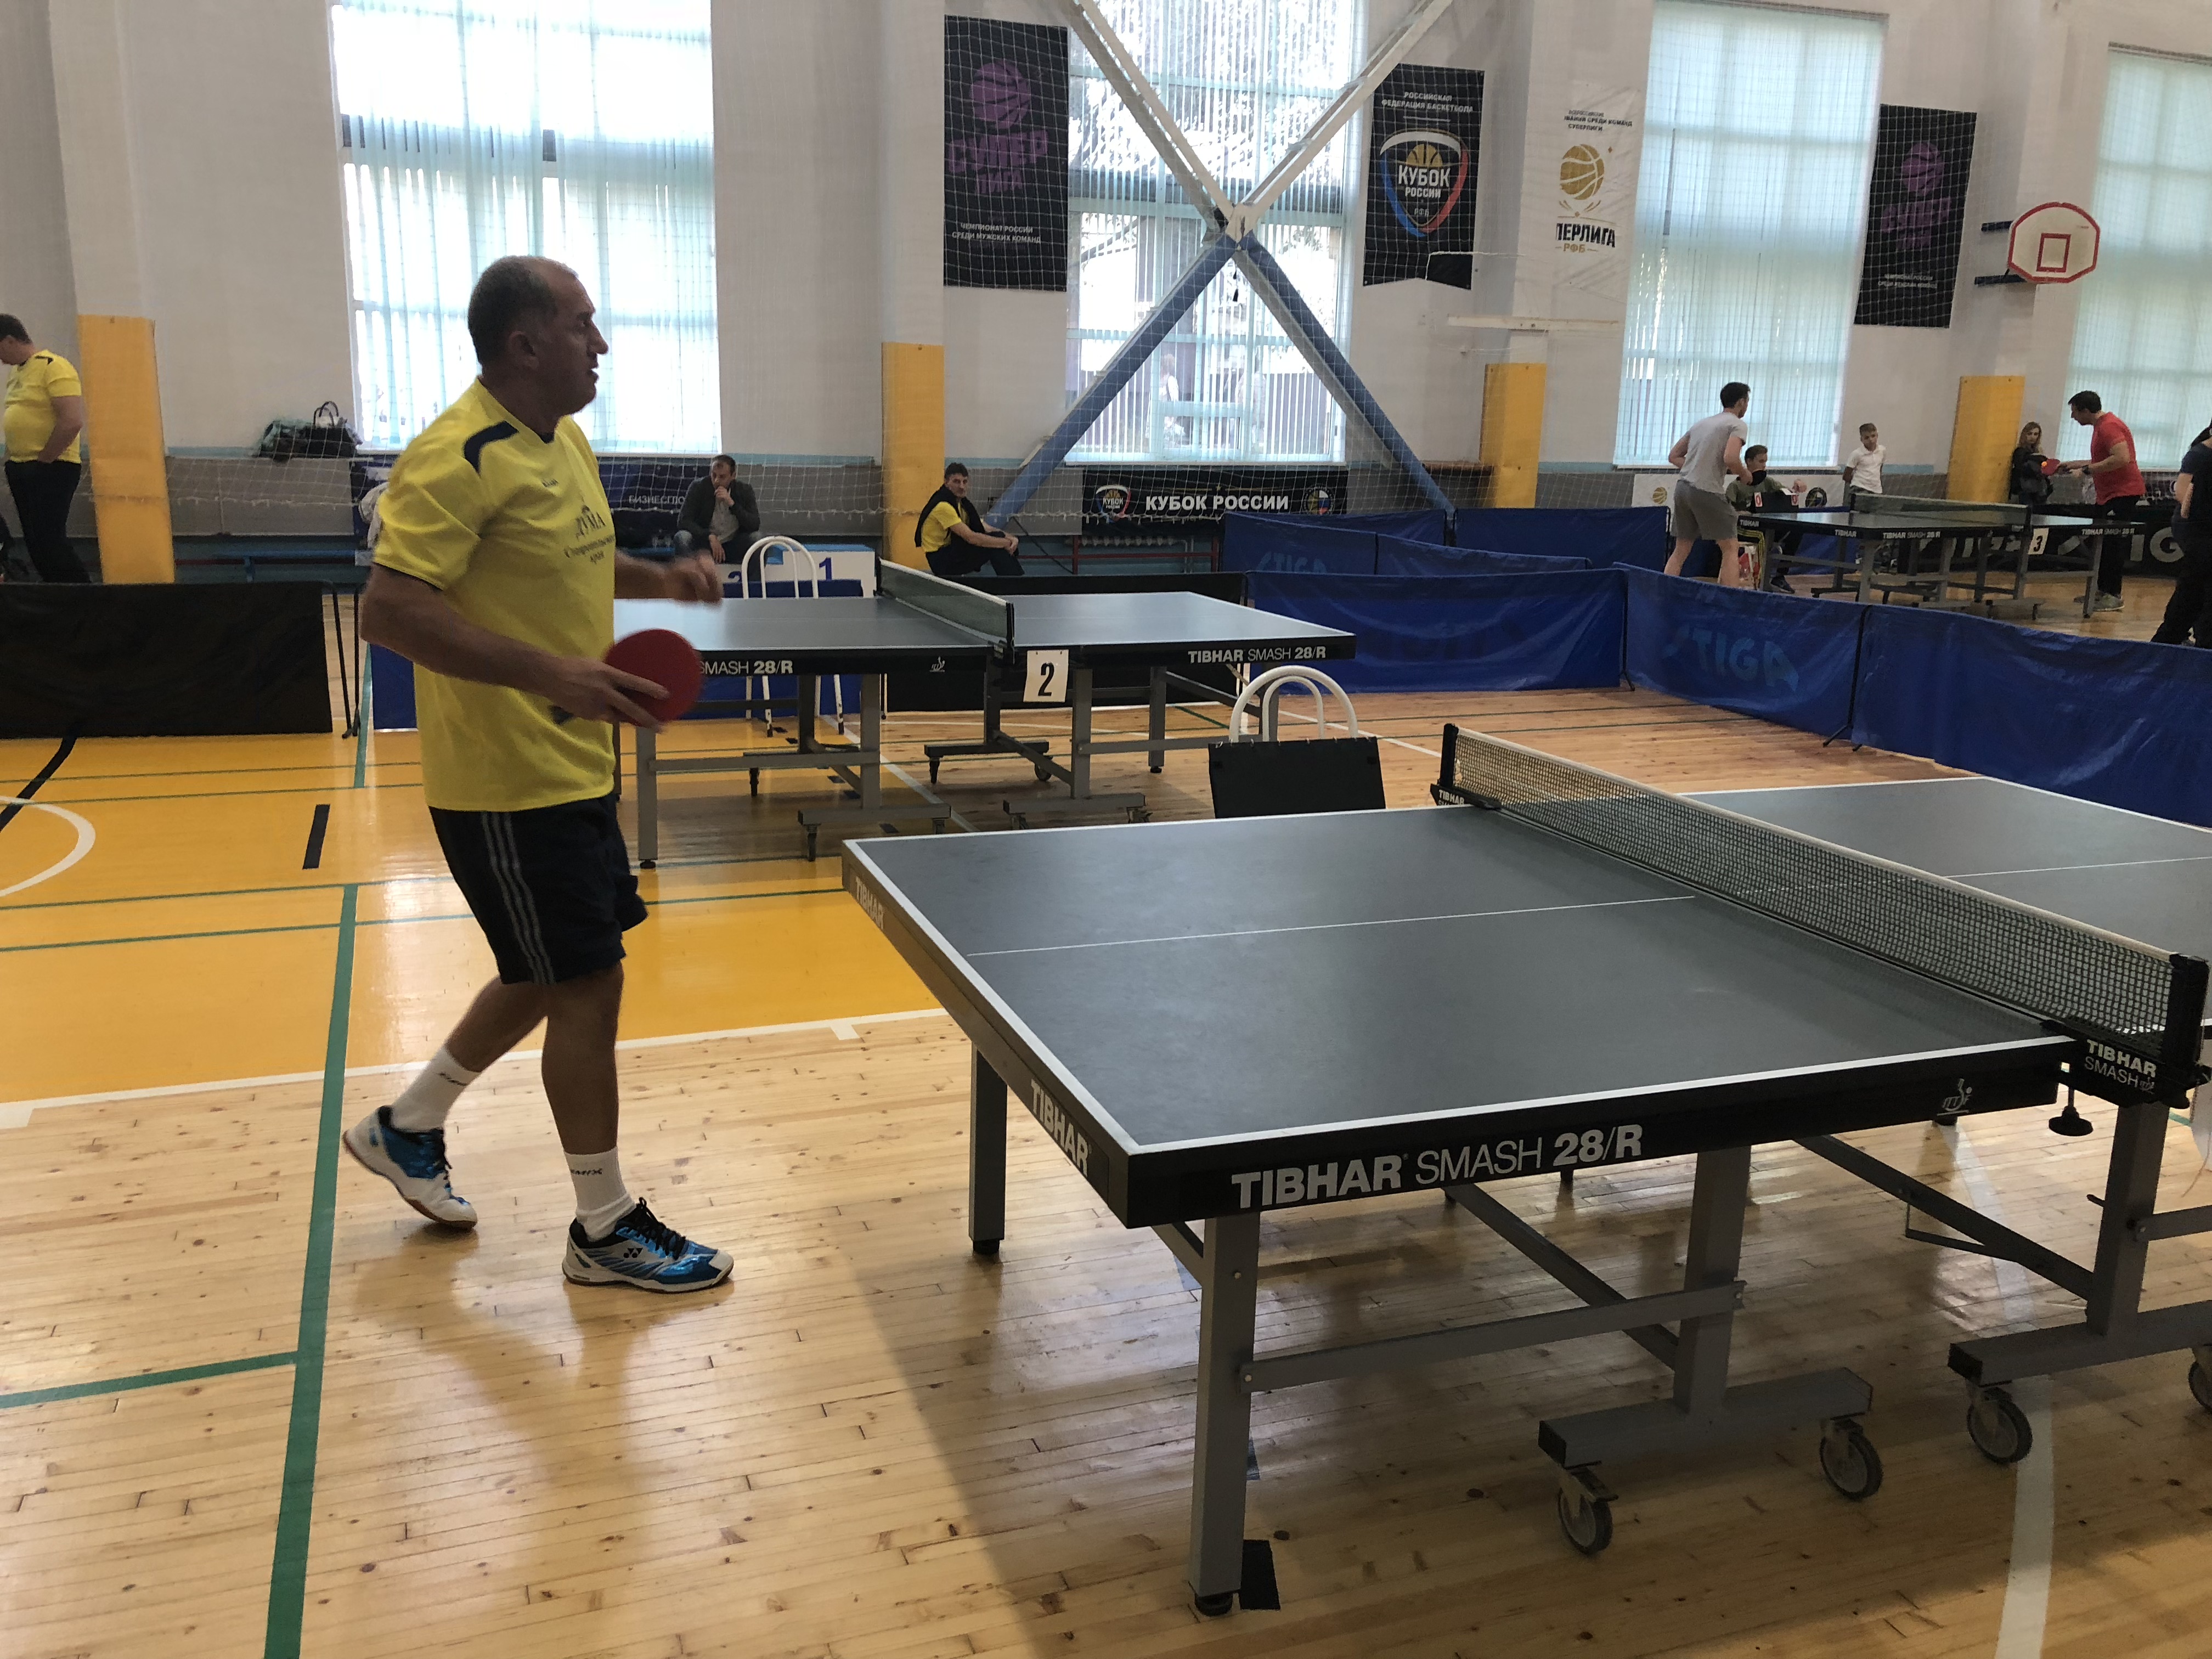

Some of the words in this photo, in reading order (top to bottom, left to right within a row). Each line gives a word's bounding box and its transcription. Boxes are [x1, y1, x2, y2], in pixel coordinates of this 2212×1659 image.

[1381, 99, 1425, 109] ФЕДЕРАЦИЯ
[1398, 165, 1451, 187] КУБОК
[1405, 187, 1441, 198] РОССИИ
[961, 223, 1002, 232] ЧЕМПИОНАТ
[1005, 225, 1033, 233] РОССИИ
[952, 231, 975, 240] СРЕДИ
[977, 233, 1011, 241] МУЖСКИХ
[1012, 235, 1041, 244] КОМАНД
[1564, 243, 1585, 253] РФБ
[1146, 495, 1206, 511] КУБОК
[1213, 495, 1288, 510] РОССИИ
[2033, 535, 2043, 552] 3
[819, 557, 832, 582] 1
[1188, 649, 1244, 664] TIBHAR
[1248, 647, 1291, 662] SMASH
[1295, 646, 1326, 659] 28/R
[699, 661, 748, 675] SMASH
[754, 660, 793, 674] 28/R
[1038, 662, 1054, 697] 2
[856, 876, 884, 930] TIBHAR
[2087, 1039, 2157, 1077] TIBHAR
[2085, 1056, 2138, 1087] SMASH
[1031, 1079, 1090, 1177] TIBHAR
[1231, 1155, 1403, 1209] TIBHAR
[1415, 1137, 1542, 1185] SMASH
[1553, 1124, 1643, 1166] 28/R
